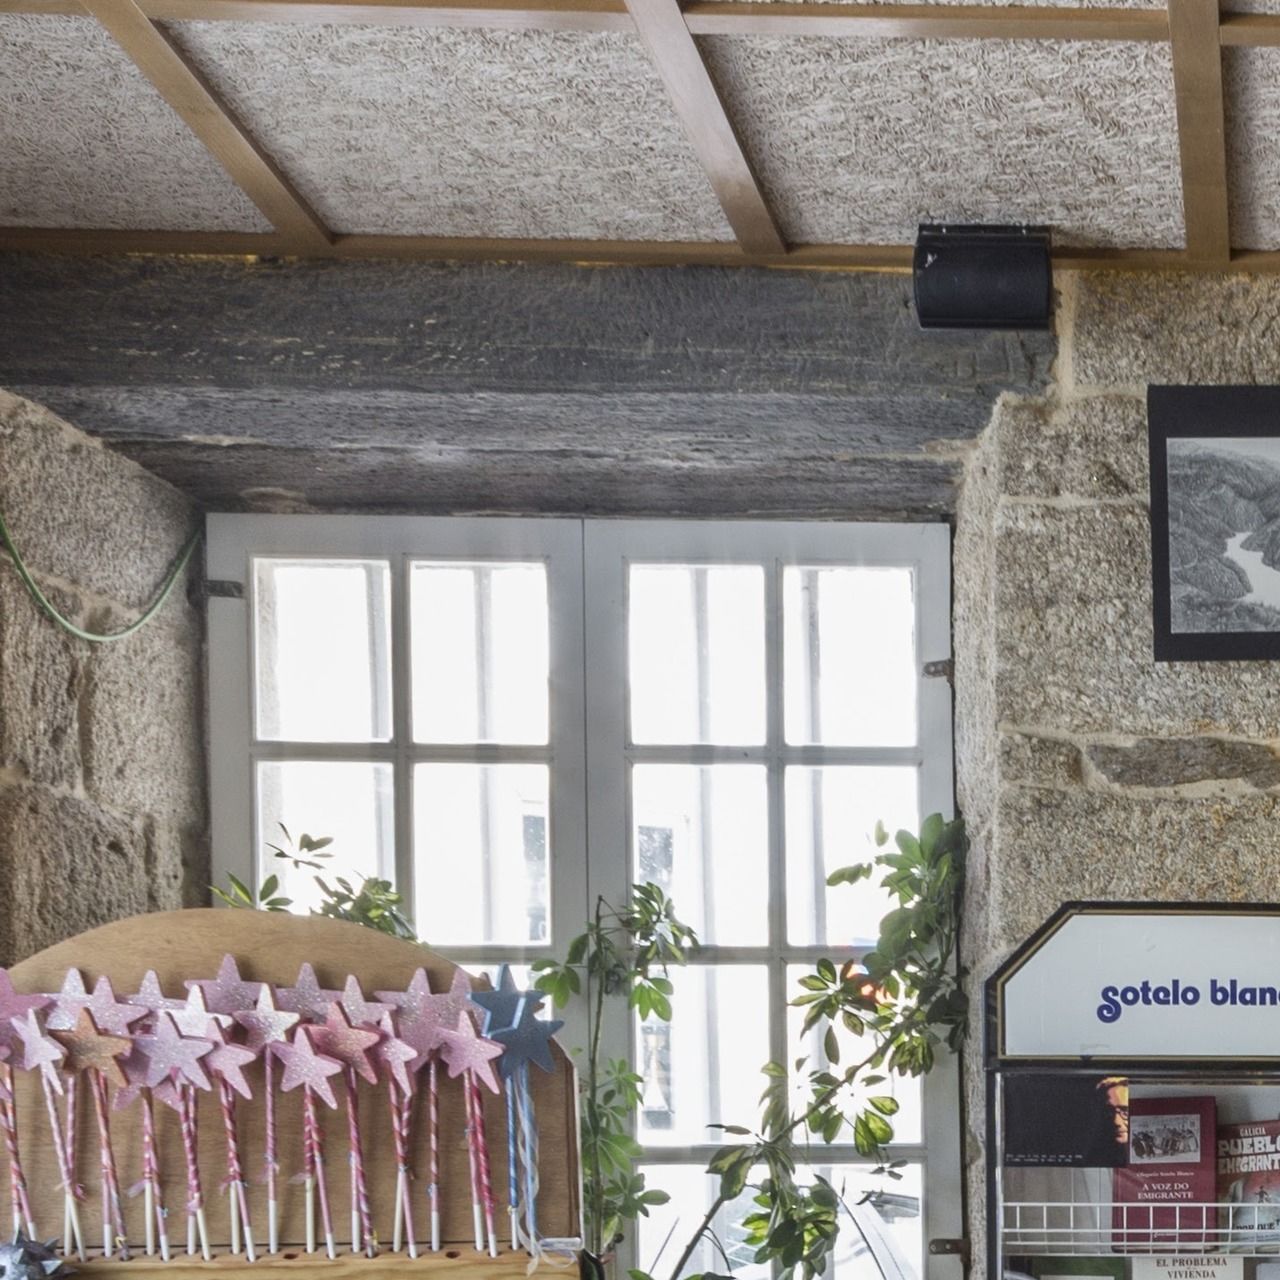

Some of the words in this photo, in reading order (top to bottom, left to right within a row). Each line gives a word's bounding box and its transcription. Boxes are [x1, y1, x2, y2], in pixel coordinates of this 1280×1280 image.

[1097, 979, 1201, 1023] sotelo
[1143, 1183, 1149, 1191] A
[1138, 1191, 1194, 1199] EMIGRANTE
[1156, 1259, 1168, 1267] EL
[1172, 1258, 1227, 1266] PROBLEMA
[1167, 1270, 1216, 1279] VIVIENDA
